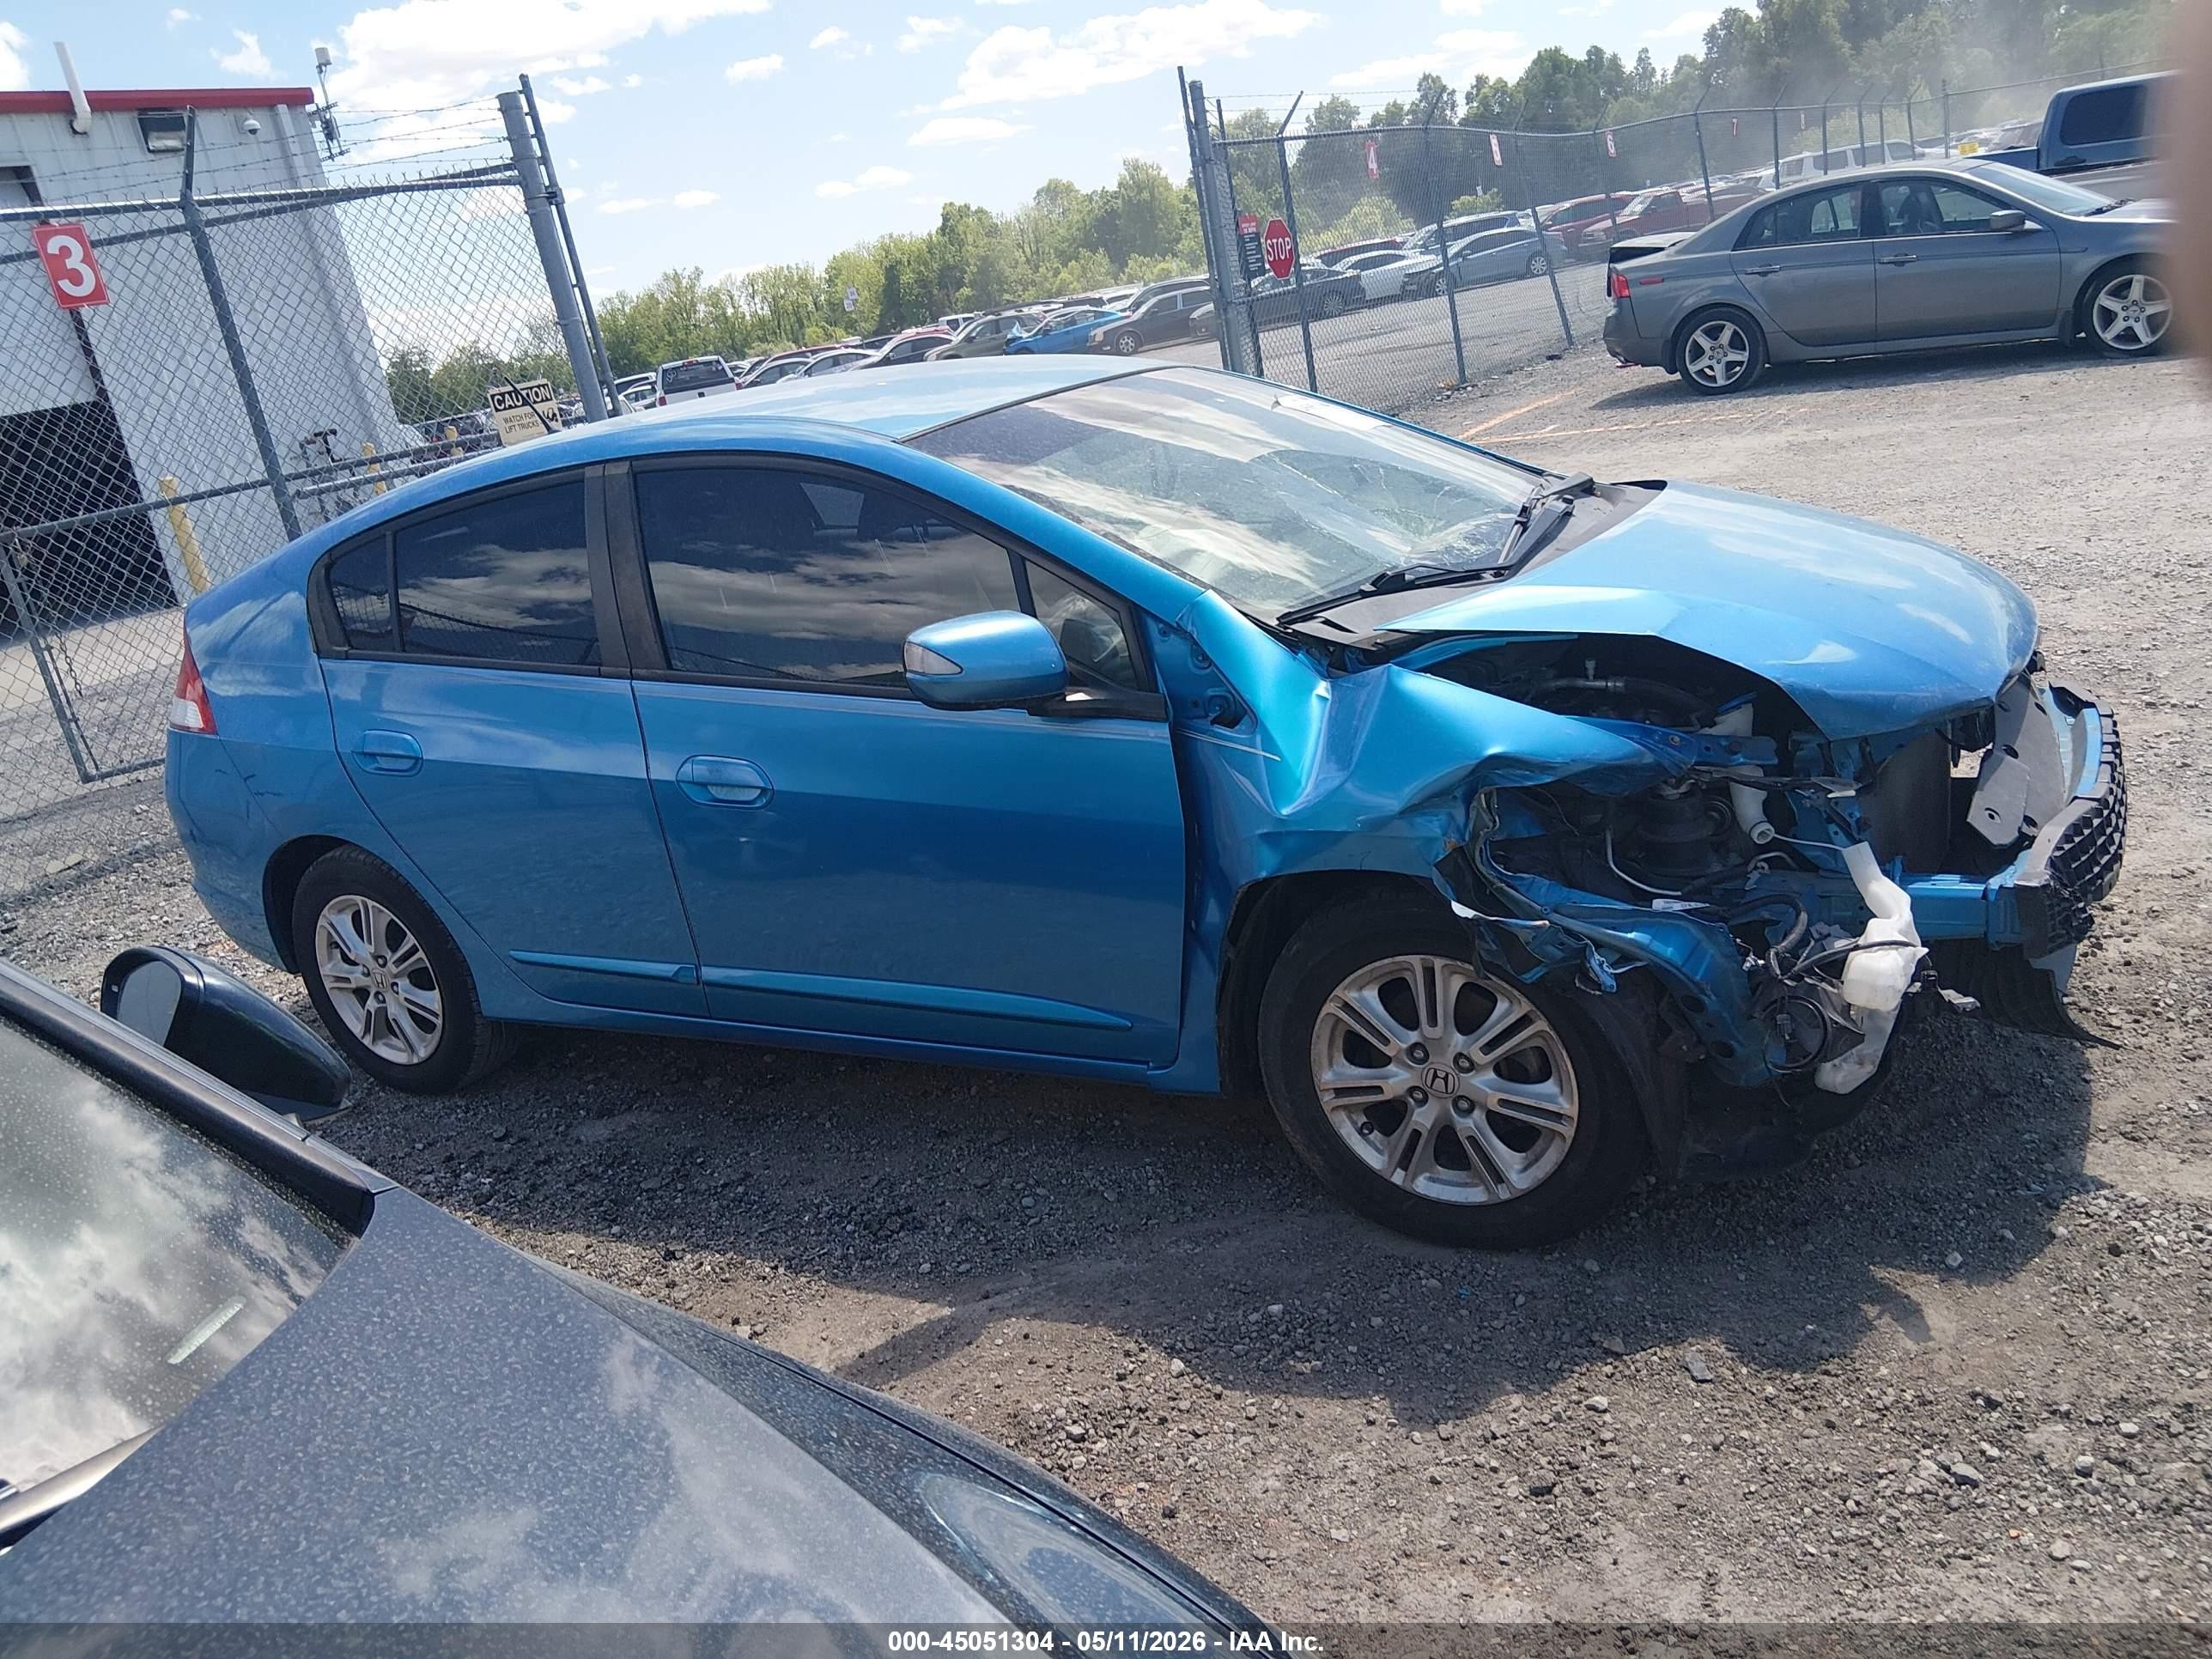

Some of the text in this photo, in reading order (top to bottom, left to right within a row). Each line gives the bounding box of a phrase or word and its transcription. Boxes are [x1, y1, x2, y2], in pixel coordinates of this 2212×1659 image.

[1607, 134, 1614, 153] 6
[1368, 146, 1377, 173] 4
[1267, 237, 1291, 261] STOP
[46, 234, 96, 298] 3
[502, 411, 537, 425] WATCH FOR
[504, 420, 540, 434] LIFT TRUCKS
